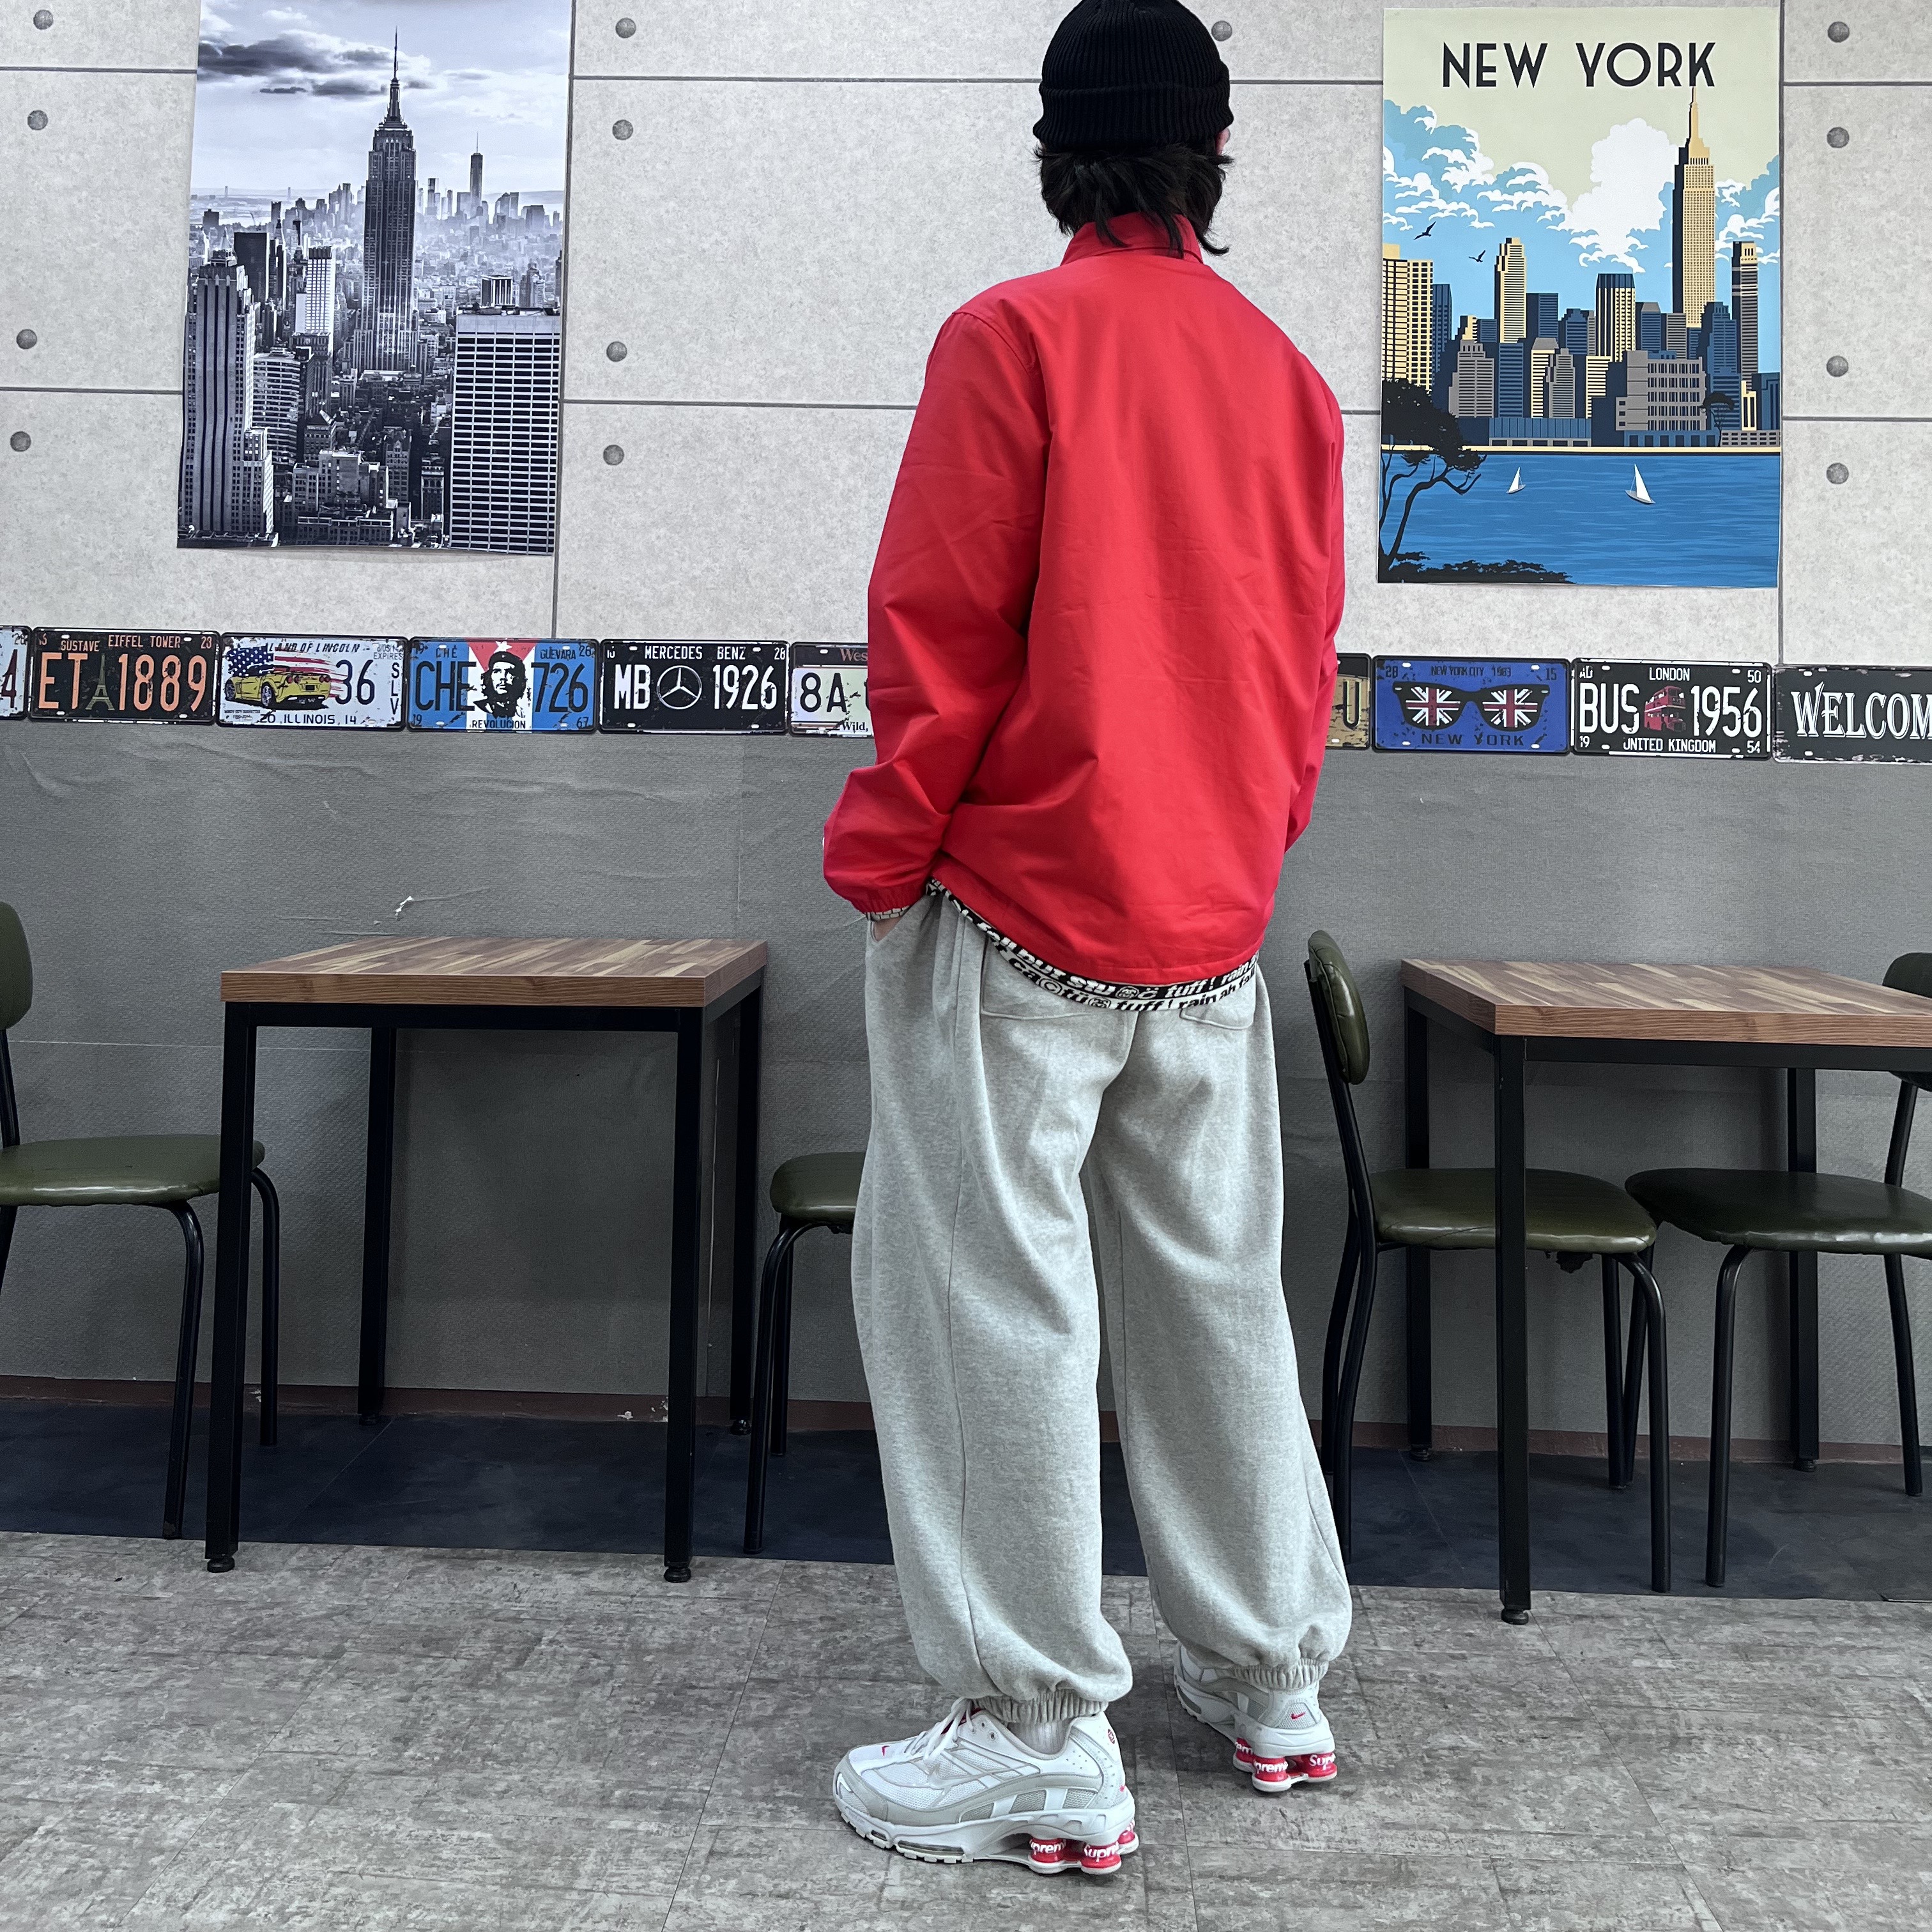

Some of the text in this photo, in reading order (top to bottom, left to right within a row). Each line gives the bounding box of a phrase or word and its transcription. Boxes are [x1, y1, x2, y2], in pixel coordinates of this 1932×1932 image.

[1443, 41, 1716, 88] NEW YORK
[61, 634, 181, 652] GUSTAVE EIFFEL TOWER
[269, 643, 360, 652] LAND OF LINCOLN
[540, 648, 576, 660] GUEVARA
[645, 645, 746, 660] MERCEDES BENZ
[1431, 666, 1447, 676] NEW
[1448, 666, 1468, 676] YORK
[1649, 667, 1690, 682] LONDON
[1747, 670, 1761, 683] 50
[38, 652, 207, 712] ET 1889
[335, 659, 375, 705] 36
[416, 661, 588, 713] CHE 726
[614, 664, 778, 710] MB 1926
[1579, 682, 1762, 738] BUS 1956
[284, 714, 335, 724] ILLINOIS
[345, 714, 356, 724] 14
[471, 719, 526, 729] REVOLUCION
[576, 716, 589, 728] 67
[1422, 733, 1524, 746] NEW YORK
[1579, 735, 1590, 747] 19
[1623, 737, 1716, 753] UNITED KINGDOM
